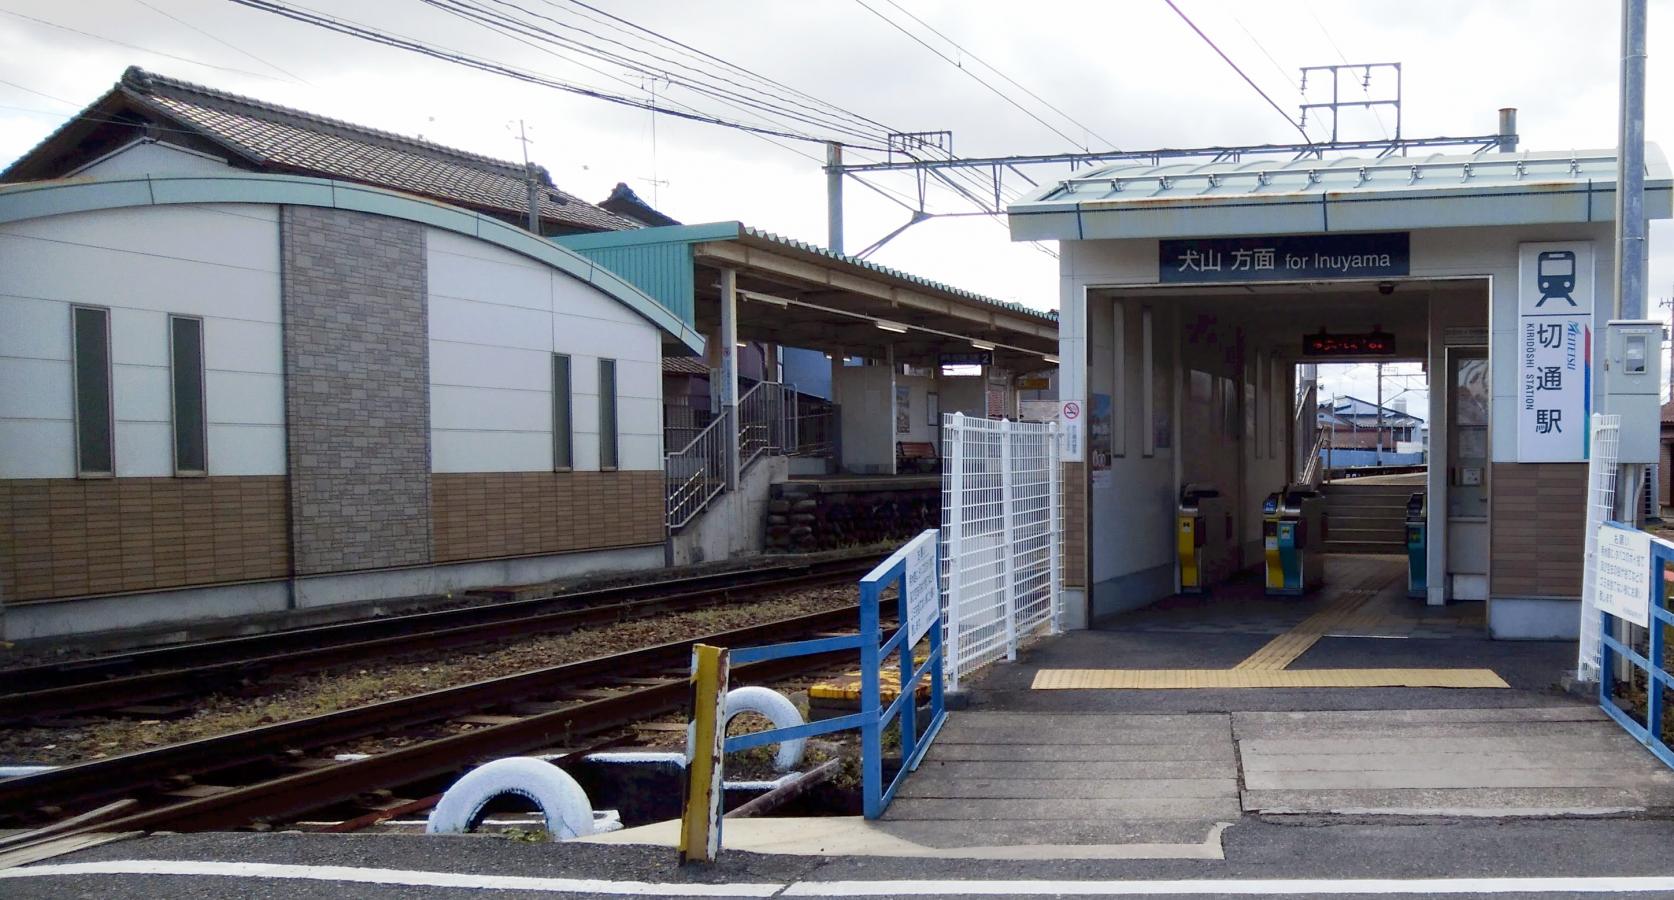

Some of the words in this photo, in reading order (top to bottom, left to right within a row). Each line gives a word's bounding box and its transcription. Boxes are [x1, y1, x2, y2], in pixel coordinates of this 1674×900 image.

[1178, 249, 1221, 272] 犬山
[1231, 248, 1276, 271] 方面
[1285, 253, 1309, 270] for
[1315, 252, 1391, 272] Inuyama
[1526, 374, 1534, 410] STATION
[1536, 323, 1562, 434] 切通駅
